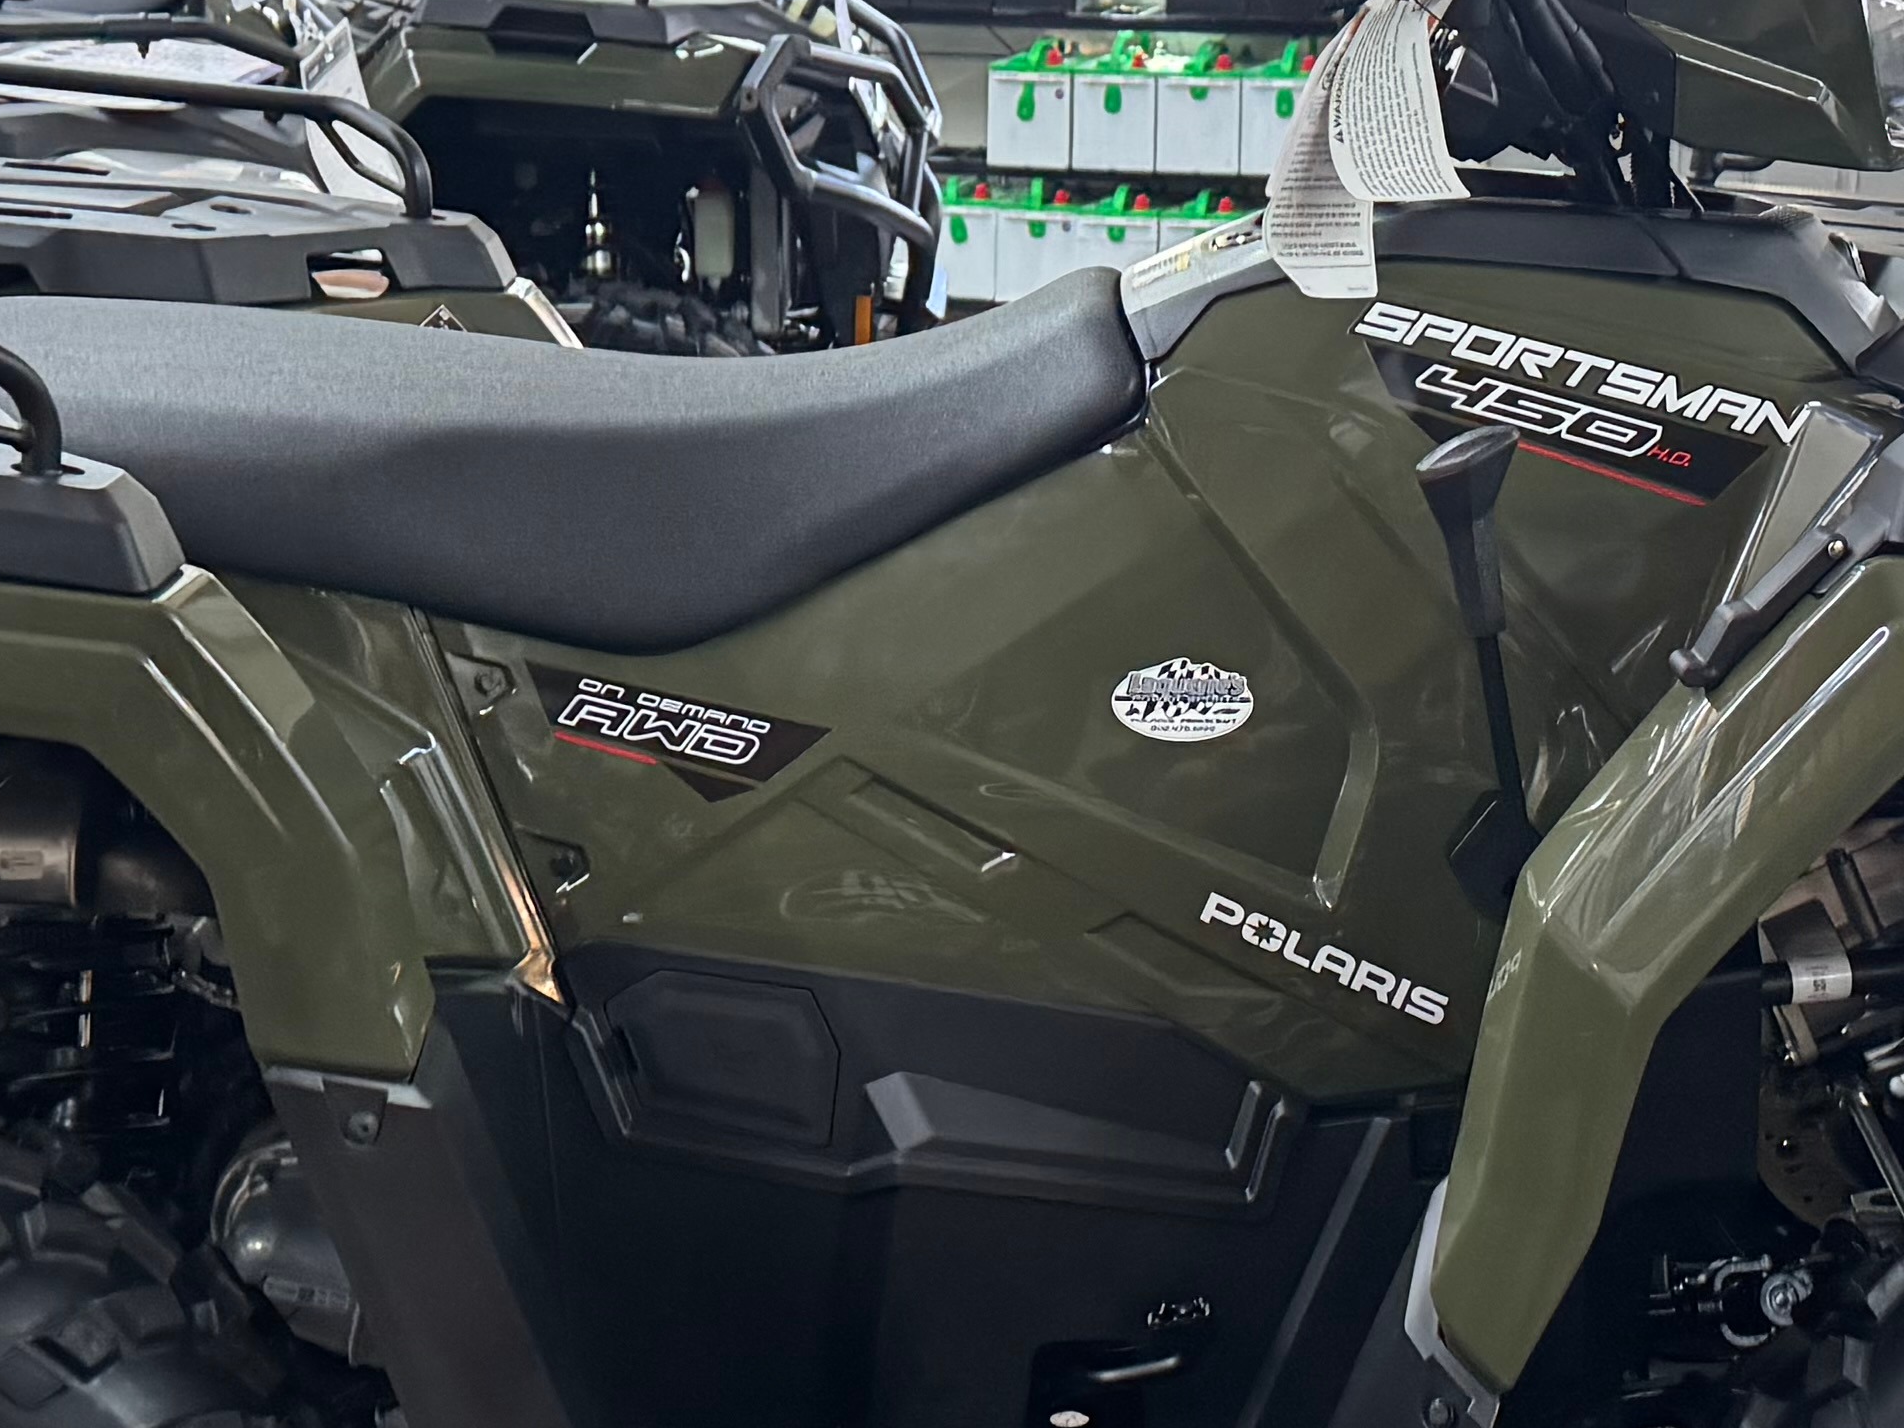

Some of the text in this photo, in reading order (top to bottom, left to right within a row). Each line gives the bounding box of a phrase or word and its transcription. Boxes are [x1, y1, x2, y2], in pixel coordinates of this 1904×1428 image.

[1354, 301, 1813, 447] SPORTSMAN
[1414, 363, 1664, 459] 450
[557, 694, 760, 765] AWD
[637, 692, 771, 734] DEMAND
[1199, 891, 1449, 1025] POLARIS
